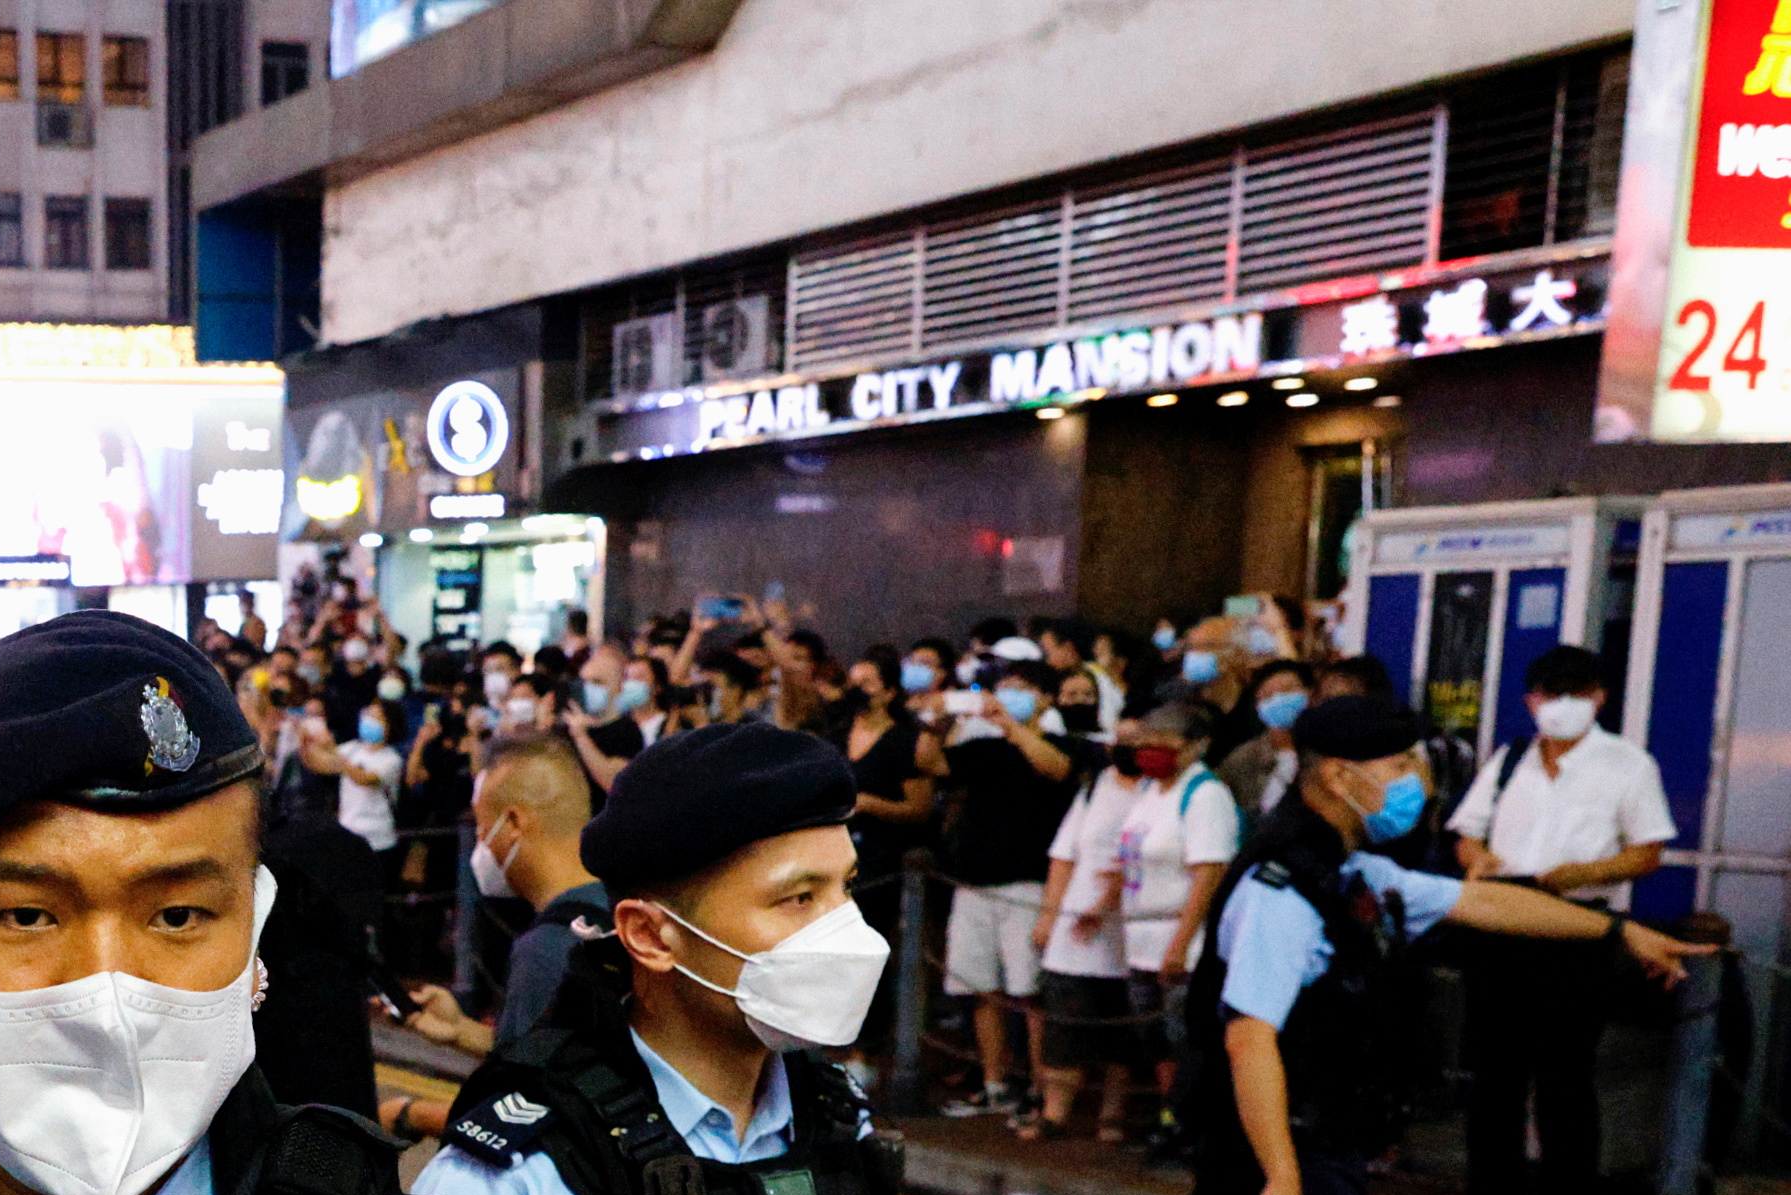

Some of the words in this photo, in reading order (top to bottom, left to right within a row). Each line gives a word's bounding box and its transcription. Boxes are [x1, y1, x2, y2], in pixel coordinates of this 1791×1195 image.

[699, 382, 830, 440] PEARL
[851, 361, 963, 420] CITY
[989, 315, 1262, 402] MANSION
[456, 1120, 508, 1150] 58612
